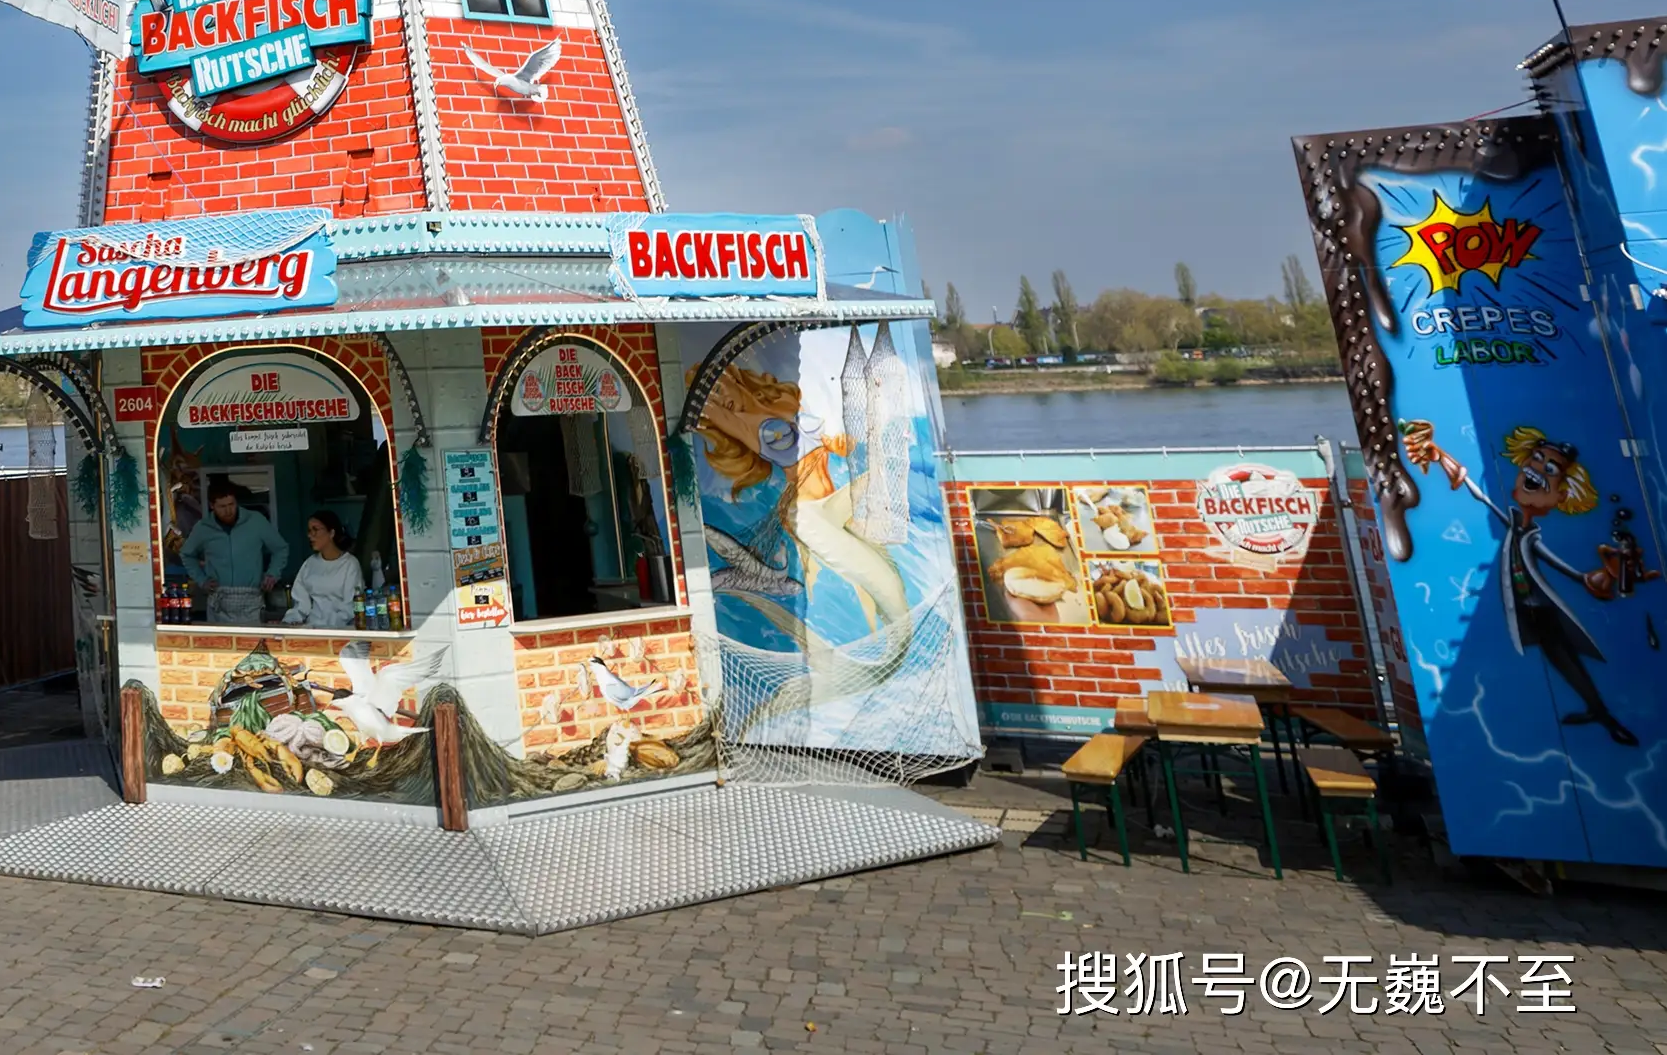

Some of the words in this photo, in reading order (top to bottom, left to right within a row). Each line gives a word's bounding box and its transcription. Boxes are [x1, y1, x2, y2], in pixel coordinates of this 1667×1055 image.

[193, 33, 310, 96] RUTSCHE
[166, 73, 227, 129] Backfisch
[229, 111, 279, 133] macht
[283, 50, 340, 126] glücklich!
[77, 233, 183, 266] Sascha
[627, 230, 810, 281] BACKFISCH
[1417, 217, 1543, 276] POW
[43, 237, 309, 312] Langenberg
[1411, 306, 1559, 337] CREPES
[559, 349, 576, 362] DIE
[1435, 339, 1540, 365] LABOR
[251, 373, 279, 392] DIE
[555, 365, 583, 378] BACK
[556, 381, 585, 395] FISCH
[119, 398, 153, 412] 2604
[189, 398, 350, 424] BACKFISCHRUTSCHE
[549, 397, 595, 411] RUTSCHE
[1204, 497, 1311, 515] BACKFISCH
[1237, 516, 1290, 534] RUTSCHE
[1173, 632, 1226, 661] Alles
